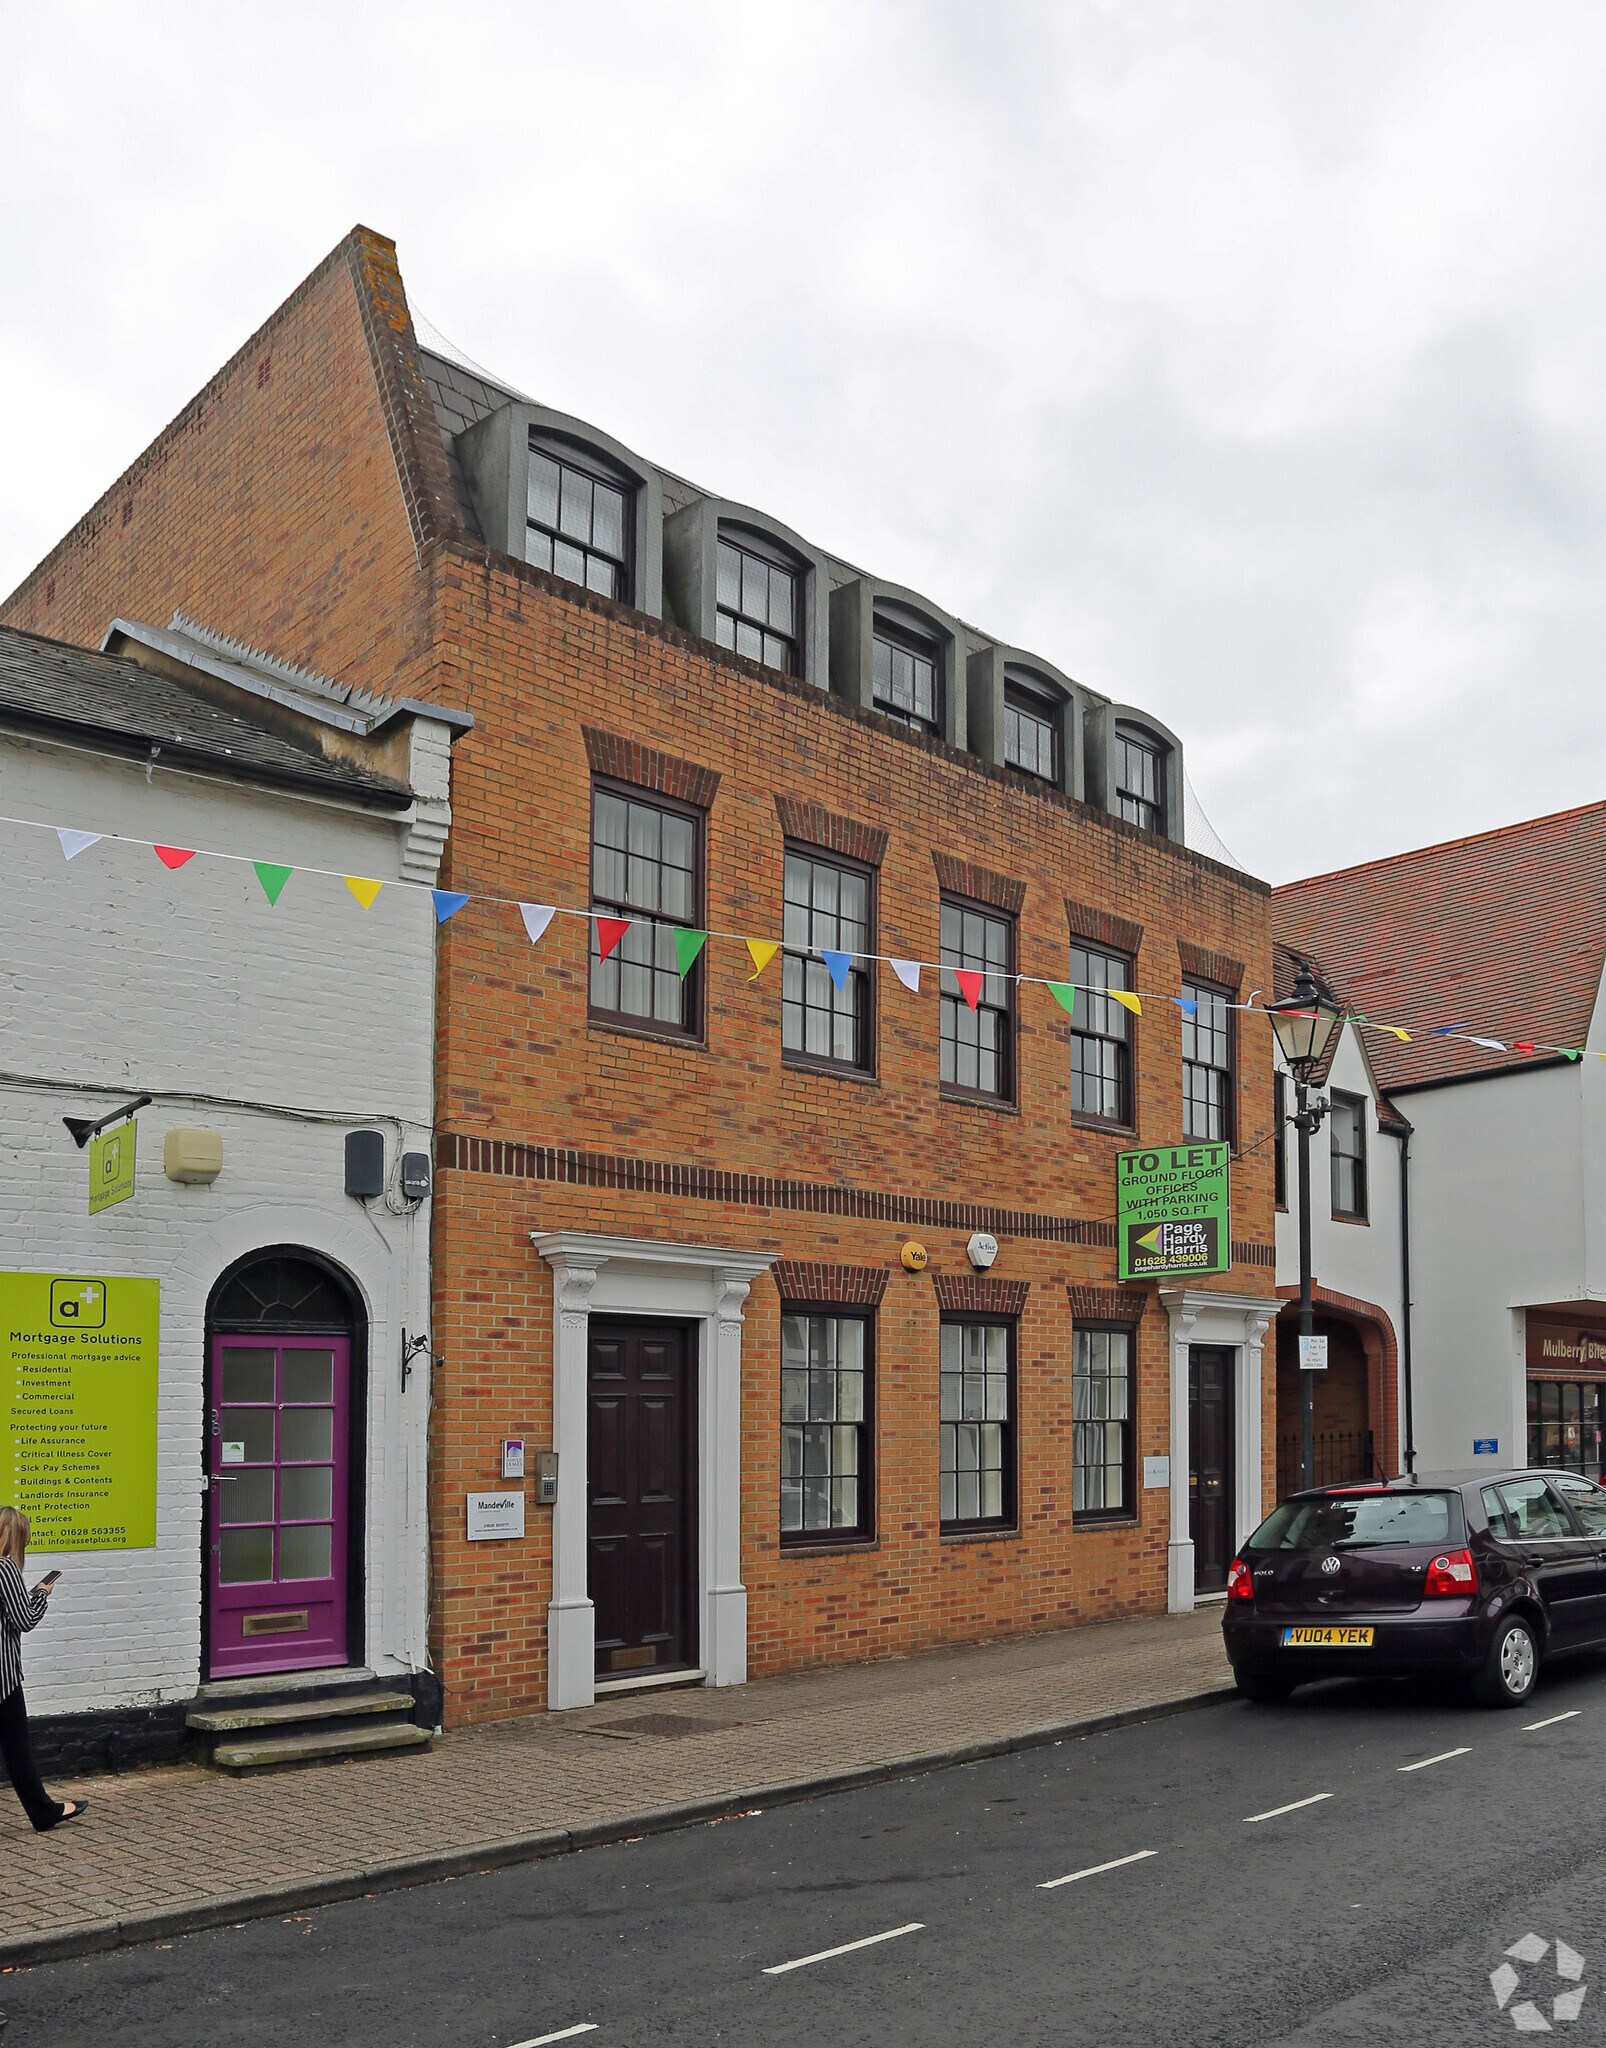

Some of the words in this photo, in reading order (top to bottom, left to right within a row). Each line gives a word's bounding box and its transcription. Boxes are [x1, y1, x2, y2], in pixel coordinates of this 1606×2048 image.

[1122, 1153, 1160, 1174] TO
[1171, 1147, 1223, 1169] LET
[1122, 1172, 1178, 1187] GROUND
[1181, 1168, 1224, 1181] FLOOR
[111, 1180, 132, 1194] Solutions
[1146, 1182, 1198, 1196] OFFICES
[1126, 1197, 1159, 1210] WITH
[1162, 1192, 1219, 1206] PARKING
[1137, 1208, 1168, 1220] 1,050
[1171, 1205, 1209, 1217] SQ.FT
[1163, 1223, 1203, 1236] Page
[1163, 1233, 1207, 1246] Hardy
[1163, 1243, 1208, 1256] Harris
[910, 1251, 926, 1262] Yale
[1134, 1256, 1167, 1267] 01628
[1169, 1253, 1208, 1264] 439006
[1134, 1261, 1208, 1273] pagehardyharris.co.uk
[10, 1331, 75, 1345] Mortgage
[80, 1333, 142, 1345] Solutions
[1543, 1338, 1584, 1363] Mulberry
[11, 1352, 66, 1360] Professional
[70, 1353, 111, 1362] mortgage
[22, 1379, 71, 1387] Investment
[22, 1392, 75, 1400] Commercial
[10, 1407, 47, 1415] Secured
[49, 1407, 74, 1415] Loans
[10, 1424, 57, 1432] Protecting
[81, 1423, 108, 1431] future
[21, 1450, 54, 1458] Critical
[56, 1450, 85, 1458] Illness
[21, 1464, 40, 1472] Sick
[43, 1464, 59, 1473] Pay
[62, 1463, 100, 1471] Schemes
[20, 1478, 62, 1486] Buildings
[73, 1476, 113, 1484] Contents
[20, 1491, 64, 1499] Landlords
[67, 1490, 109, 1498] Insurance
[20, 1503, 41, 1511] Rent
[44, 1502, 90, 1510] Protection
[91, 1526, 126, 1535] 563355
[48, 1536, 127, 1546] info@assetplus.org
[1295, 1629, 1333, 1642] VU04
[1338, 1629, 1369, 1642] YEK
